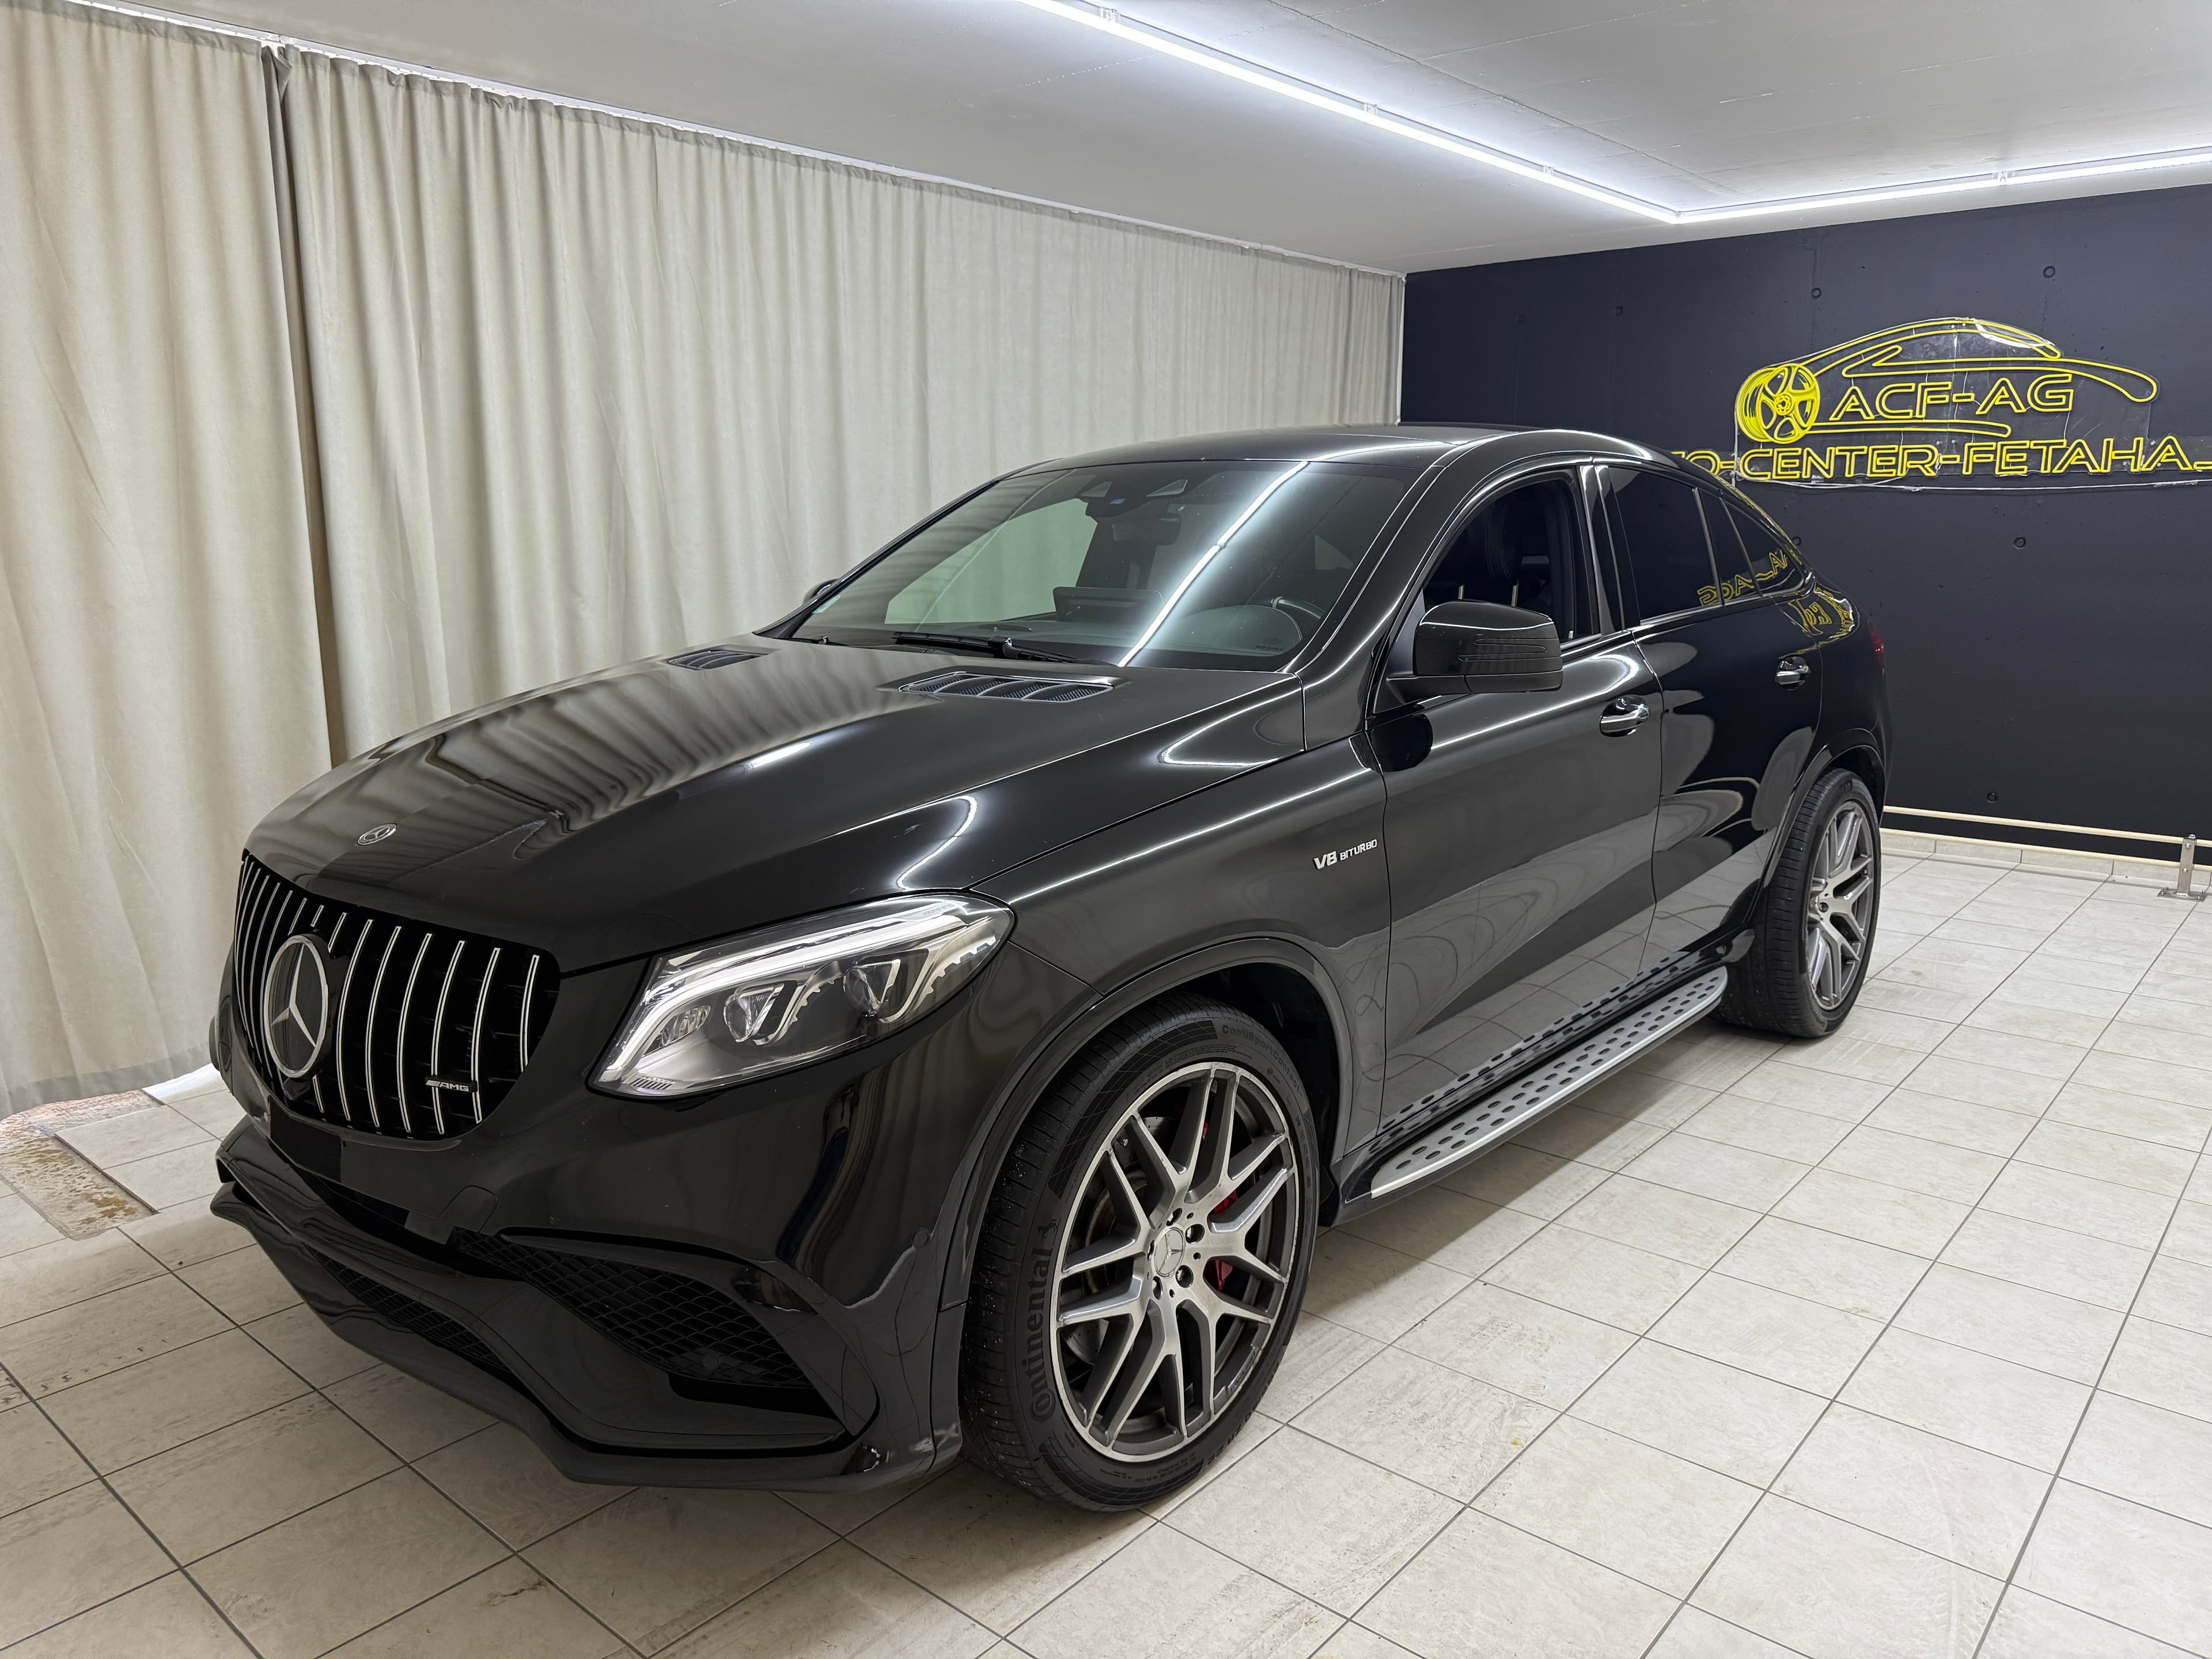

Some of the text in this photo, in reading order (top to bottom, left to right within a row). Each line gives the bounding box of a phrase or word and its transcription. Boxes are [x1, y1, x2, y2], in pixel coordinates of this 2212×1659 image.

[1830, 373, 2074, 421] ACF-AG
[1671, 435, 2212, 480] O-CENTER-FETAHA
[1313, 839, 1378, 869] V8 BITURBO
[439, 1082, 469, 1092] AMG
[1022, 1245, 1055, 1422] Continental
